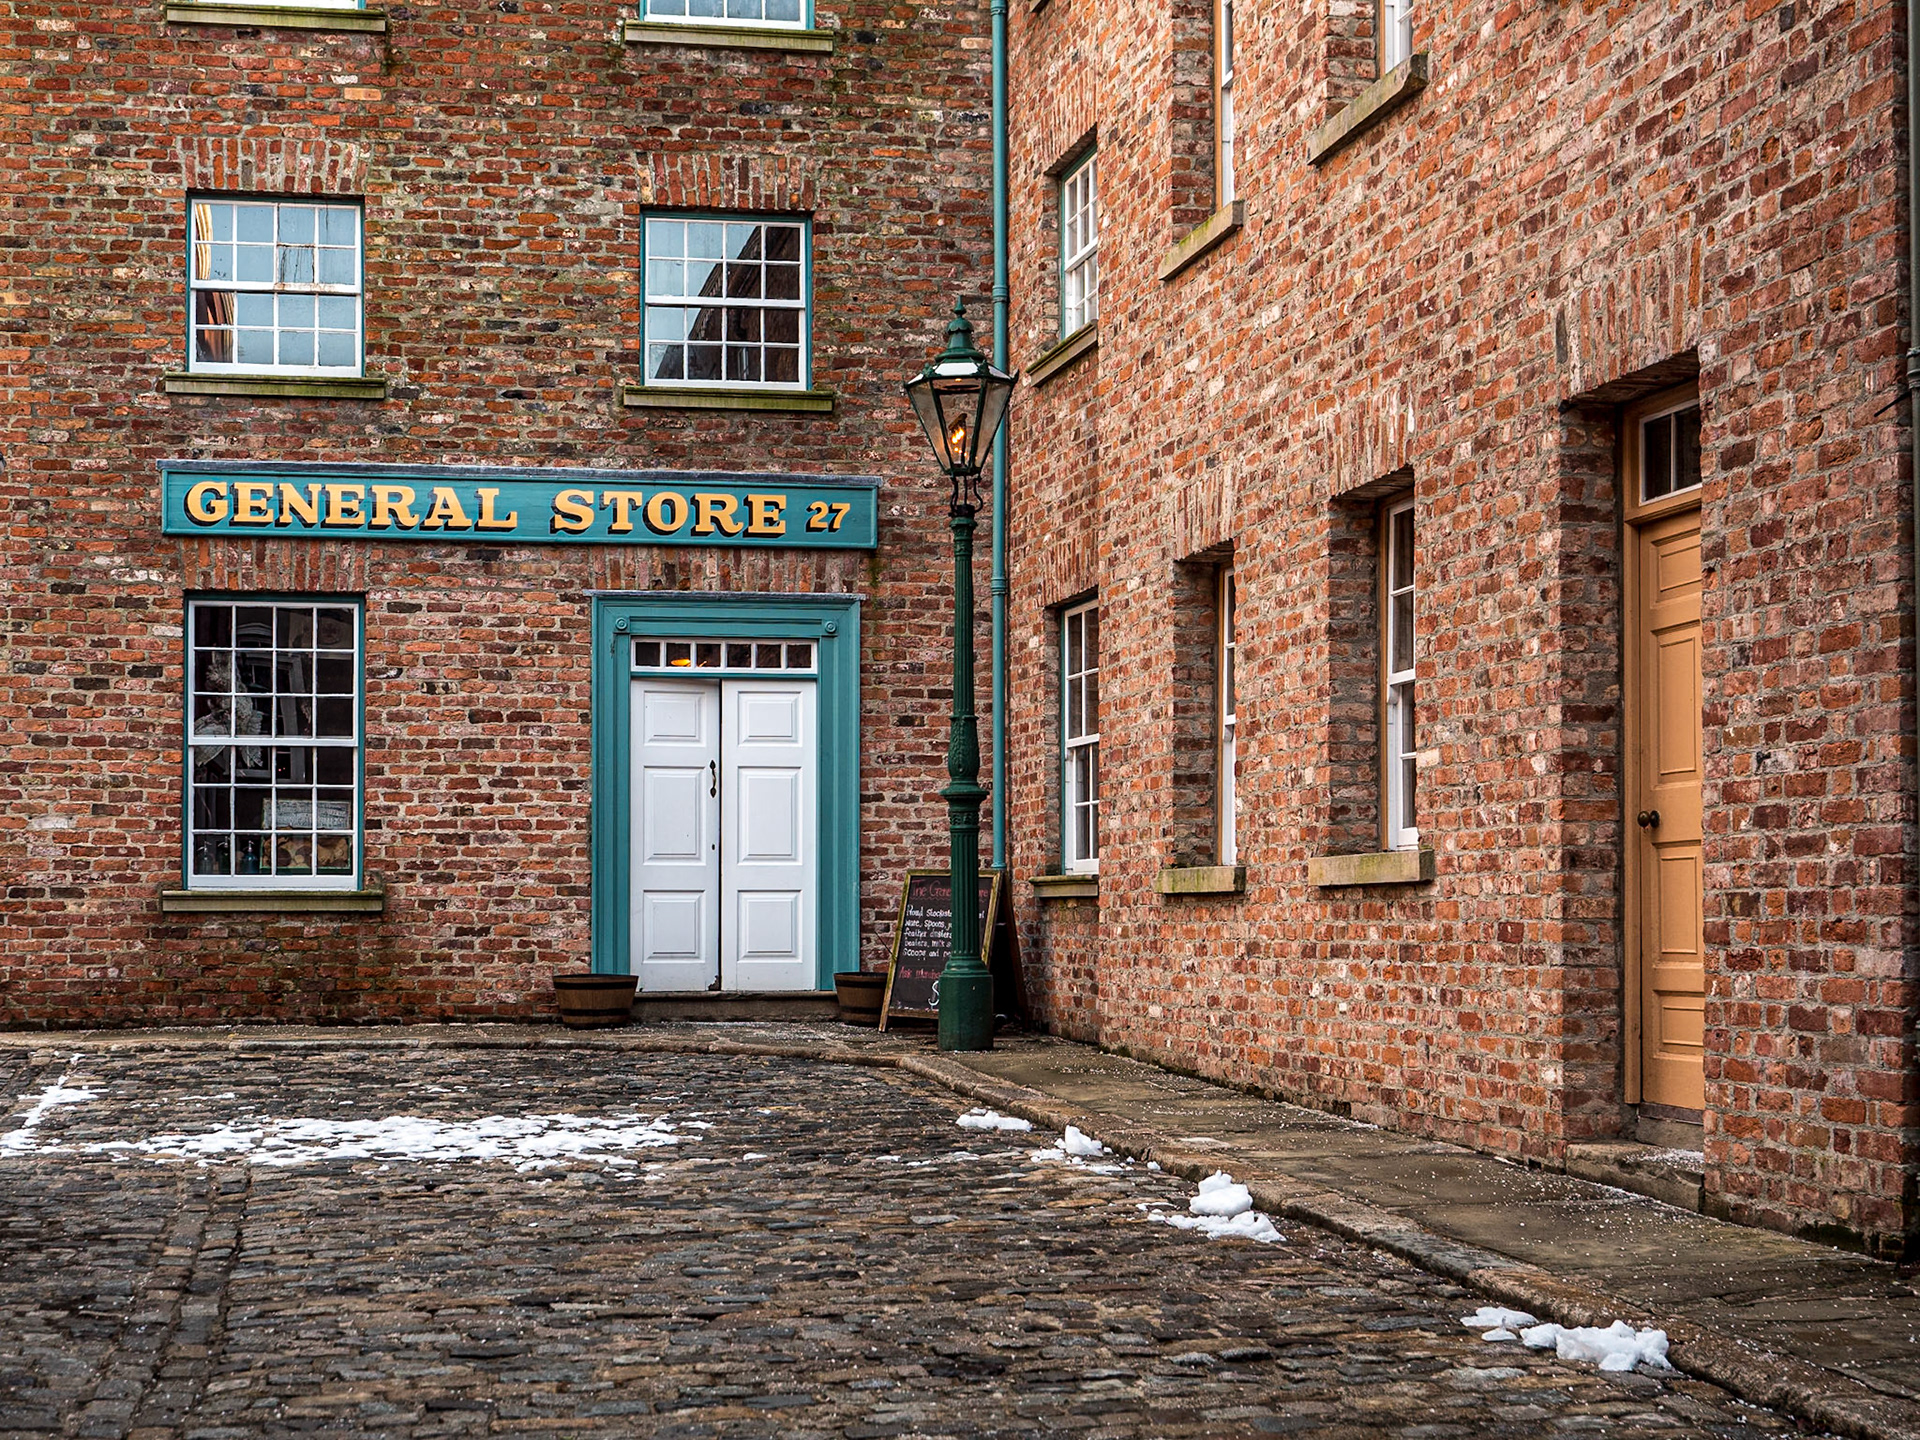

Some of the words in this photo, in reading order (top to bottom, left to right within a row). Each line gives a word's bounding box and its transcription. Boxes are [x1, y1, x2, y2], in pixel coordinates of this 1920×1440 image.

[184, 481, 517, 532] GENERAL
[550, 489, 787, 538] STORE
[806, 501, 850, 532] 27
